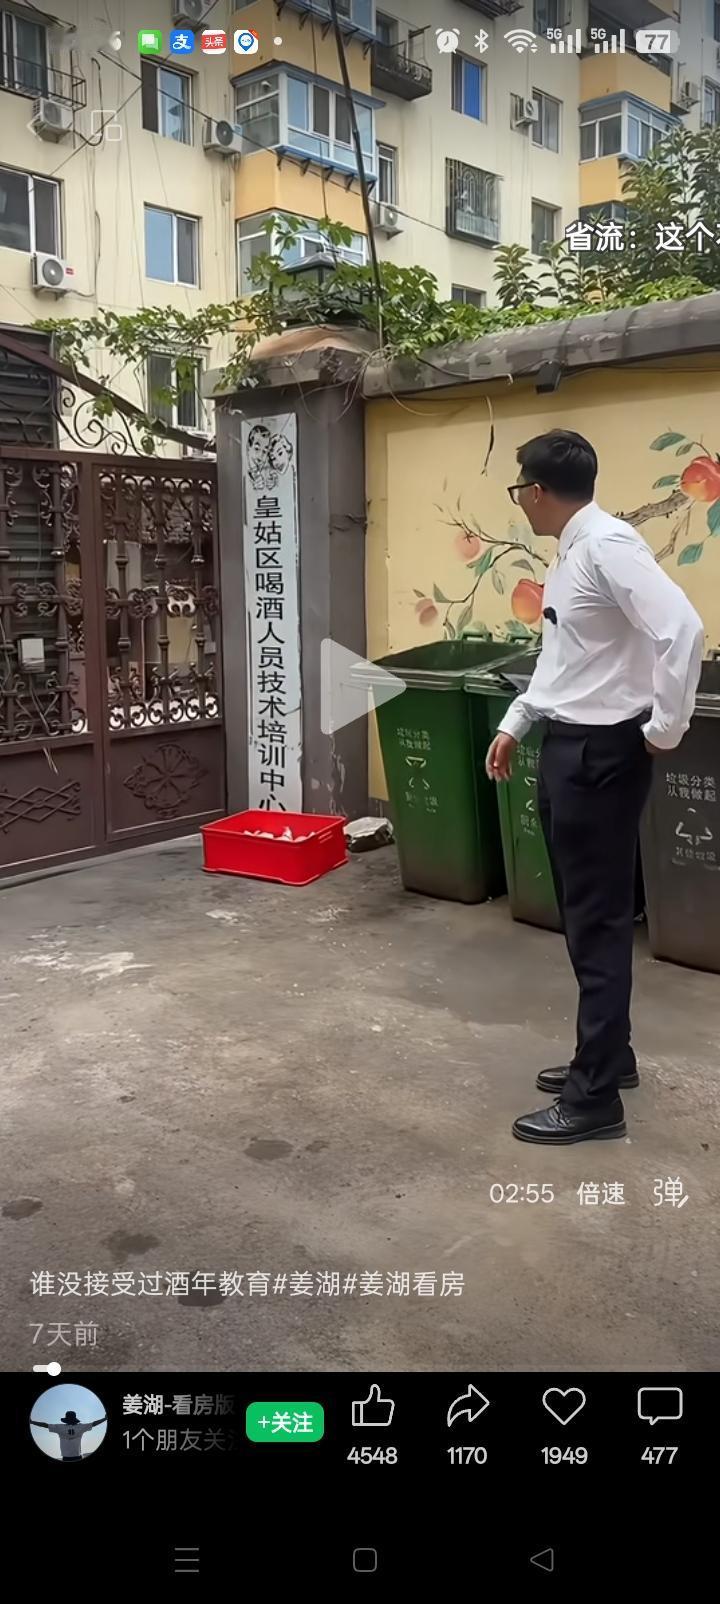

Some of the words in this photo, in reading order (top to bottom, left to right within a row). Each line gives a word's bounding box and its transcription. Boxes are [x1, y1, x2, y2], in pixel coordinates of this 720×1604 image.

[253, 495, 287, 812] 皇姑区喝酒人员技术培训中心
[666, 771, 716, 789] 垃圾分类
[667, 784, 717, 802] 从我做起
